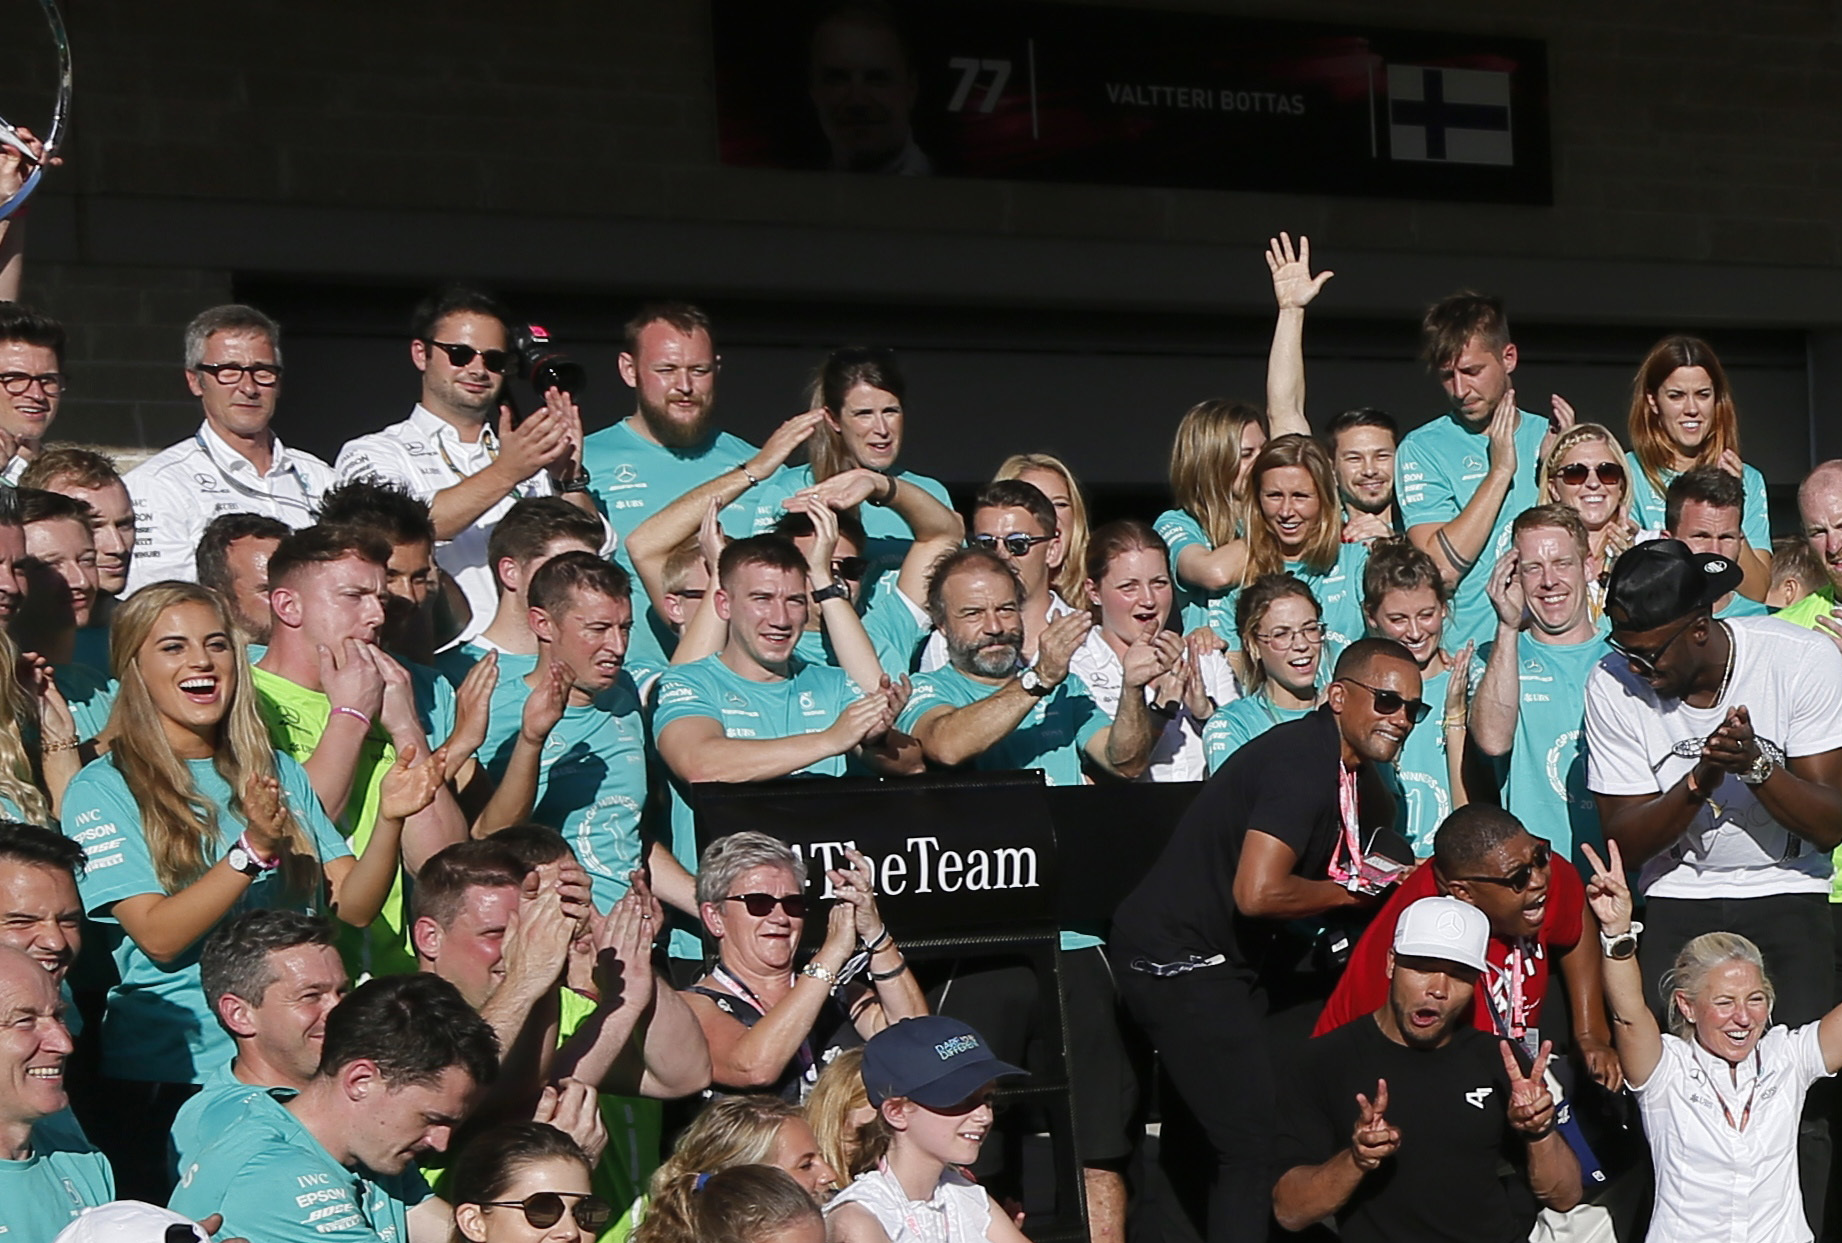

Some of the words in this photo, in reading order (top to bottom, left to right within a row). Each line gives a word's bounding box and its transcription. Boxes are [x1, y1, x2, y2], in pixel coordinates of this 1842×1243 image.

[948, 56, 1013, 114] 77
[1105, 82, 1213, 111] VALTTERI
[1219, 89, 1306, 116] BOTTAS
[1403, 473, 1424, 483] SON
[75, 808, 103, 827] IWC
[297, 1173, 331, 1188] IWC
[295, 1188, 347, 1209] EPSON
[301, 1203, 354, 1225] BOSE
